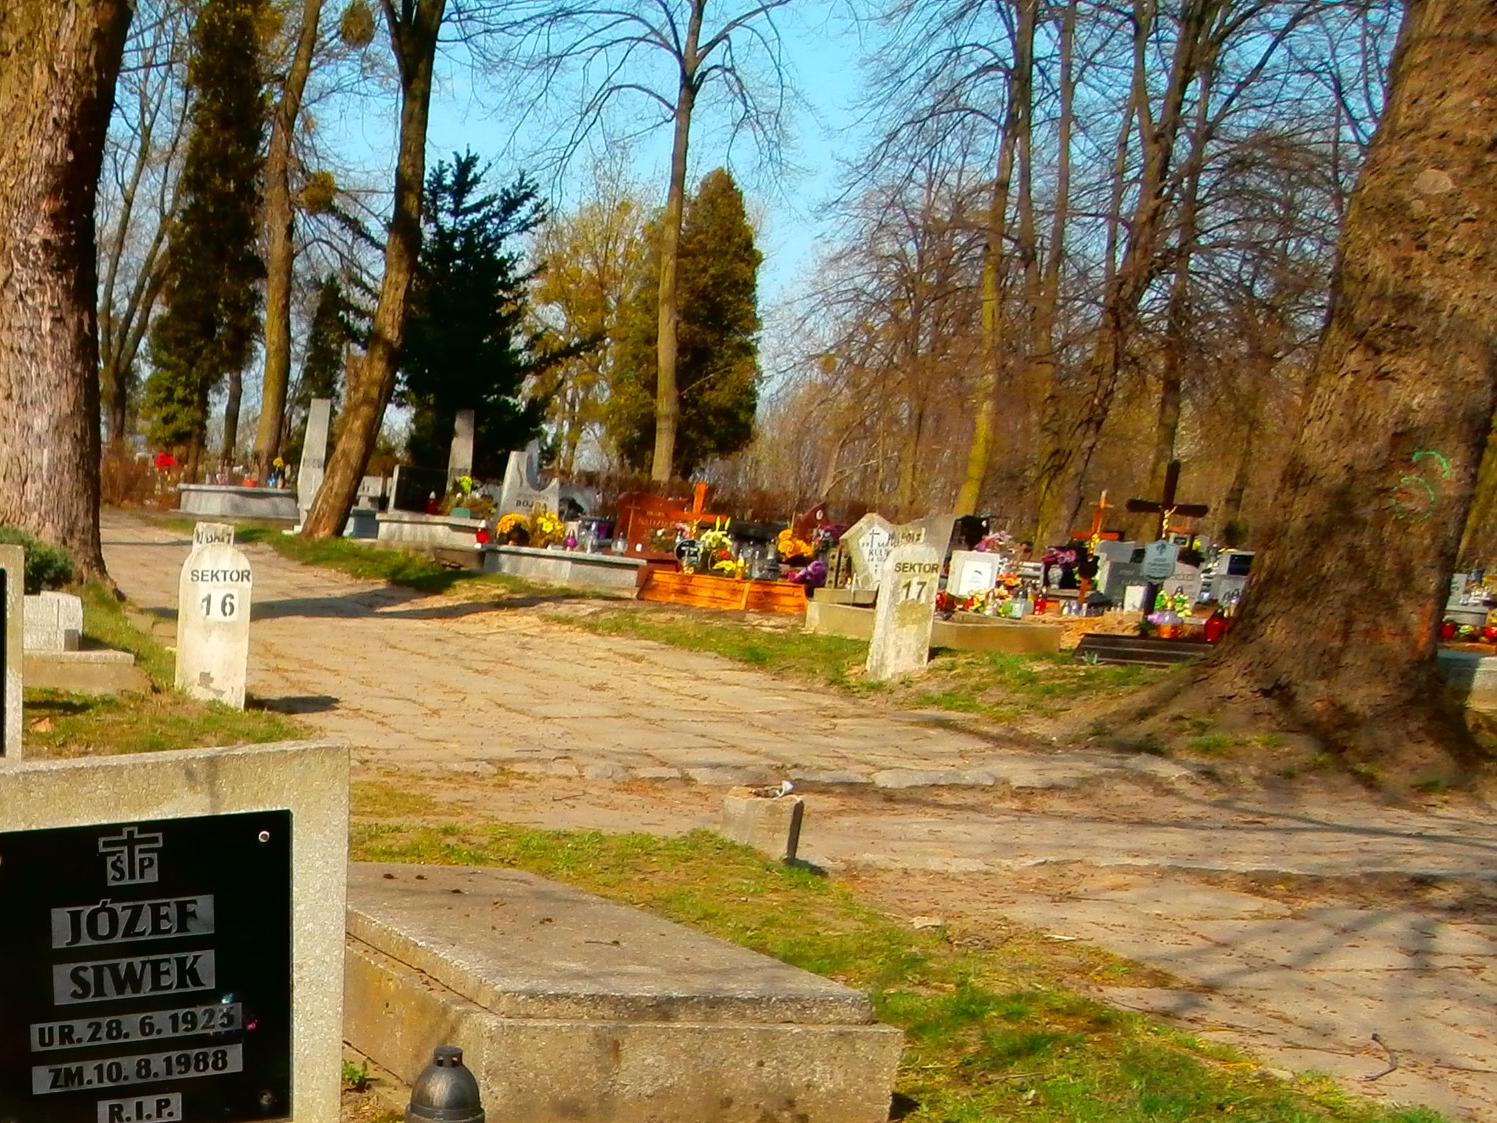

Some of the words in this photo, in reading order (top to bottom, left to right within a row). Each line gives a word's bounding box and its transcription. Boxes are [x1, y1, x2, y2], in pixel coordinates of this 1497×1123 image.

[191, 569, 251, 583] SEKTOR
[895, 562, 940, 574] SEKTOR
[902, 580, 927, 601] 17
[201, 593, 235, 617] 16
[65, 899, 199, 948] JÓZEF
[68, 954, 207, 1001] SIWEK
